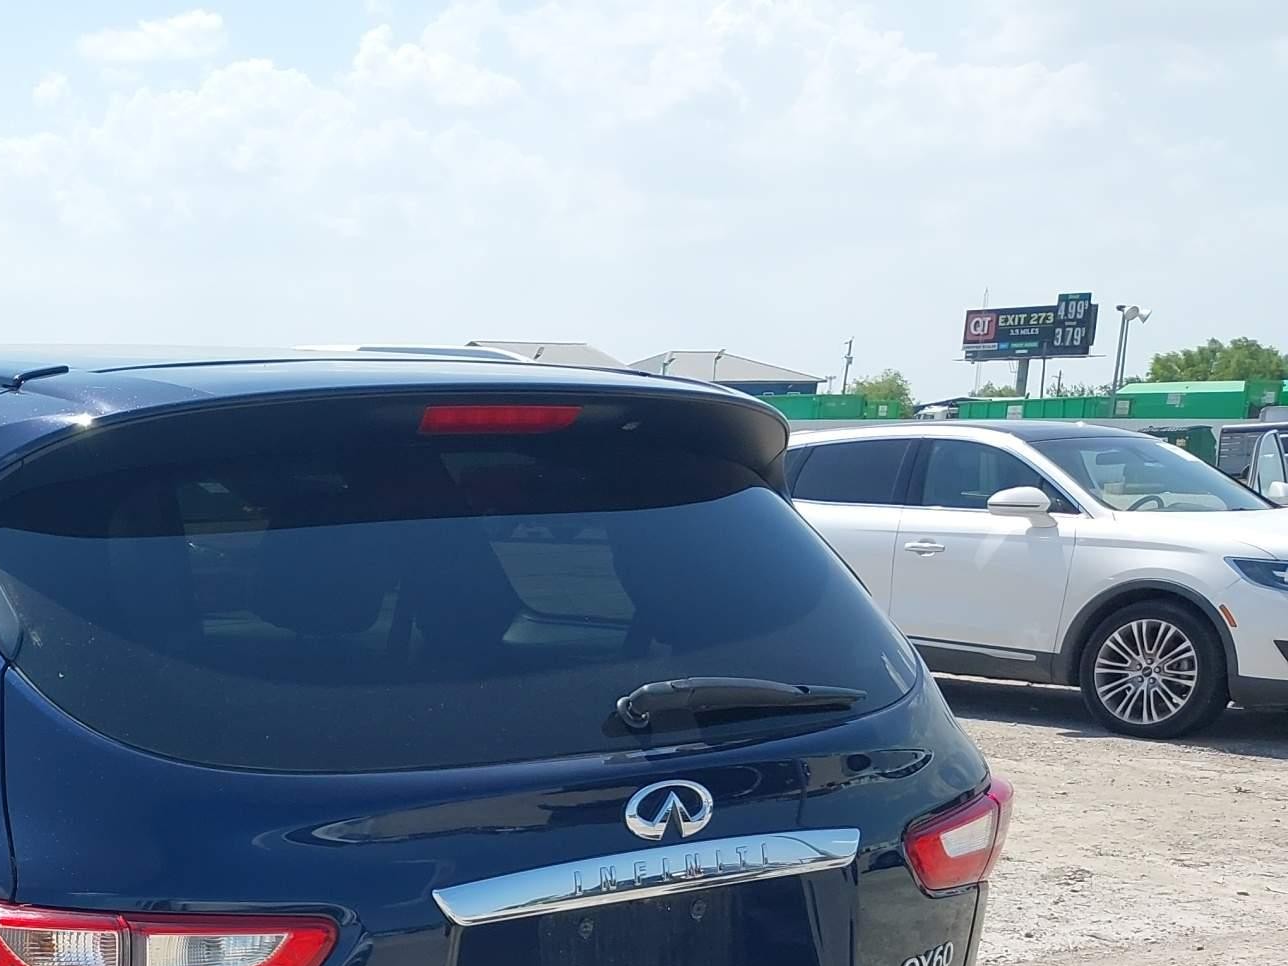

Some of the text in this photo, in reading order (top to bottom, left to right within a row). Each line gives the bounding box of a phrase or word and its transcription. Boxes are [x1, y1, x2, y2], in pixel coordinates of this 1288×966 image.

[969, 316, 992, 335] QT
[998, 312, 1055, 327] EXIT 273
[1020, 327, 1040, 335] MILES
[572, 843, 772, 896] INFINITI
